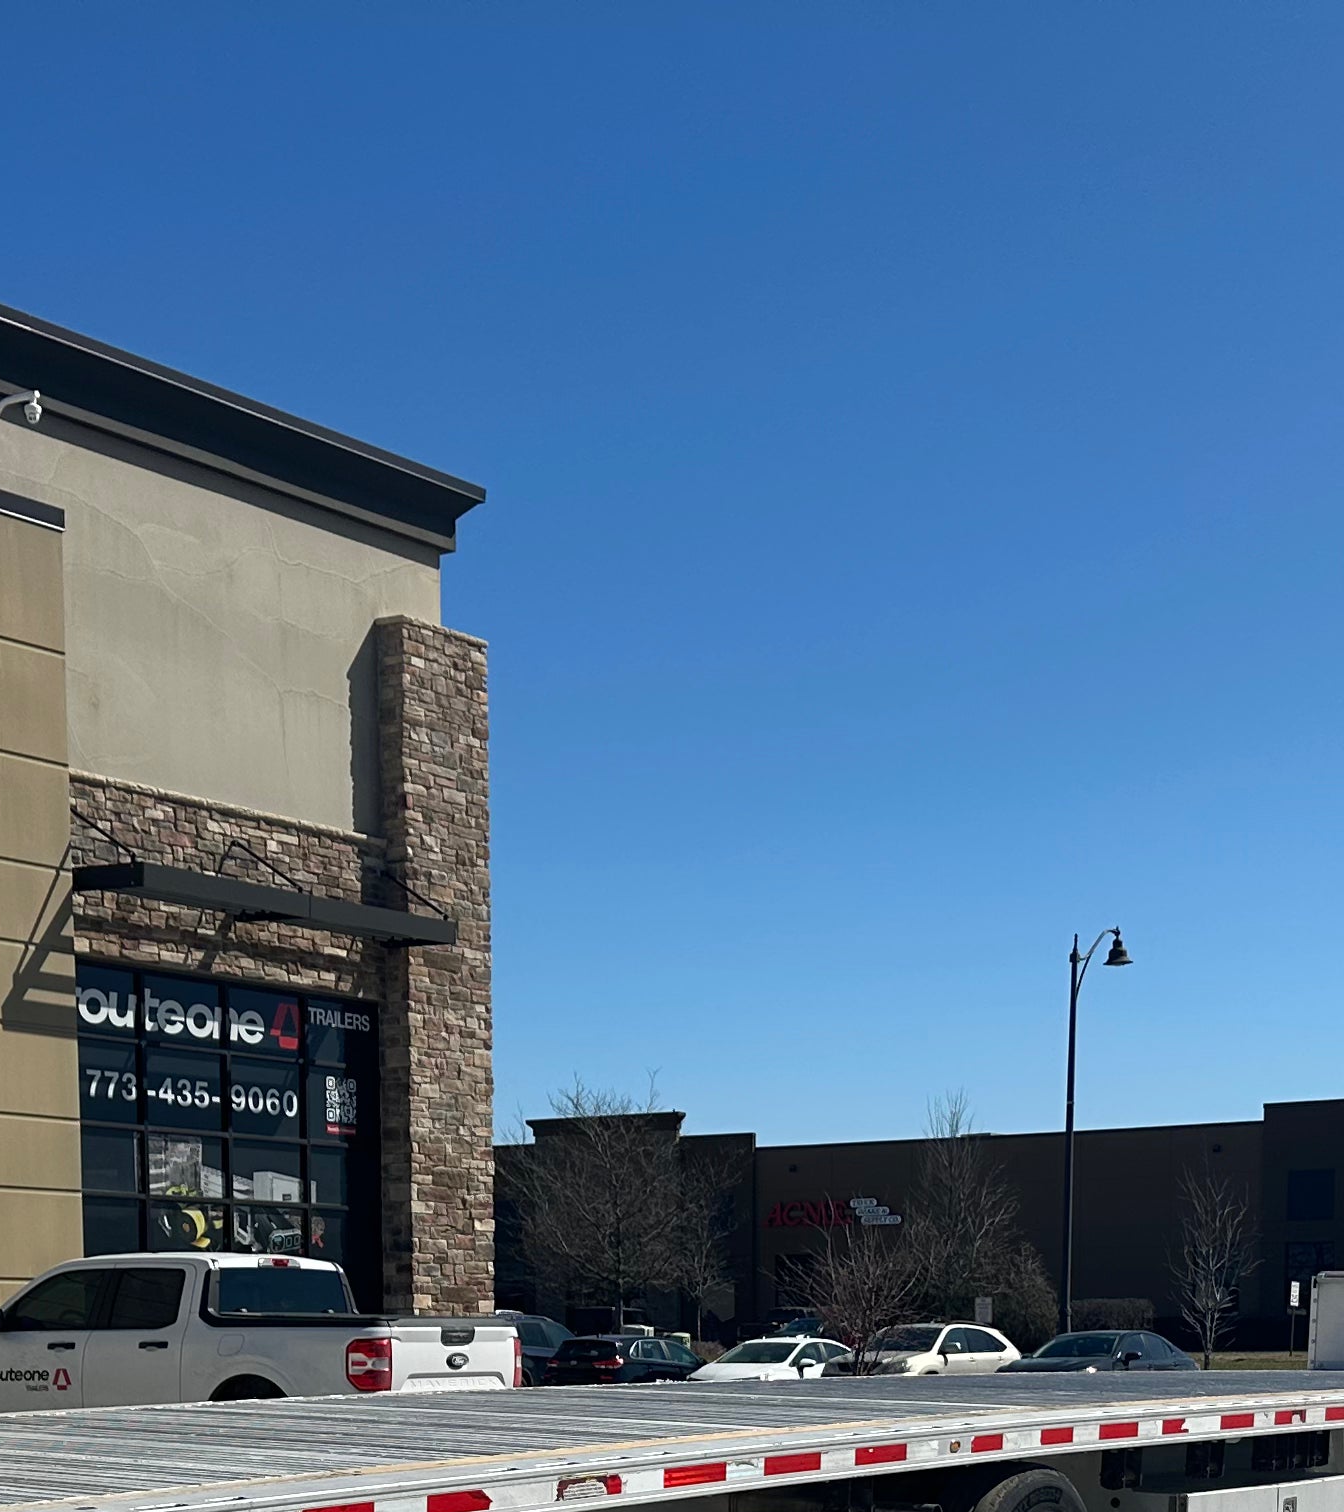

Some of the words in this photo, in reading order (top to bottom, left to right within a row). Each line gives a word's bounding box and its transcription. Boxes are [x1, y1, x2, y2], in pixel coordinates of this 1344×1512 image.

[75, 986, 265, 1044] outeone
[307, 1006, 370, 1032] TRAILERS
[85, 1068, 299, 1118] 773-435-9060
[763, 1200, 852, 1227] ACME
[410, 1378, 497, 1388] MAVERICK
